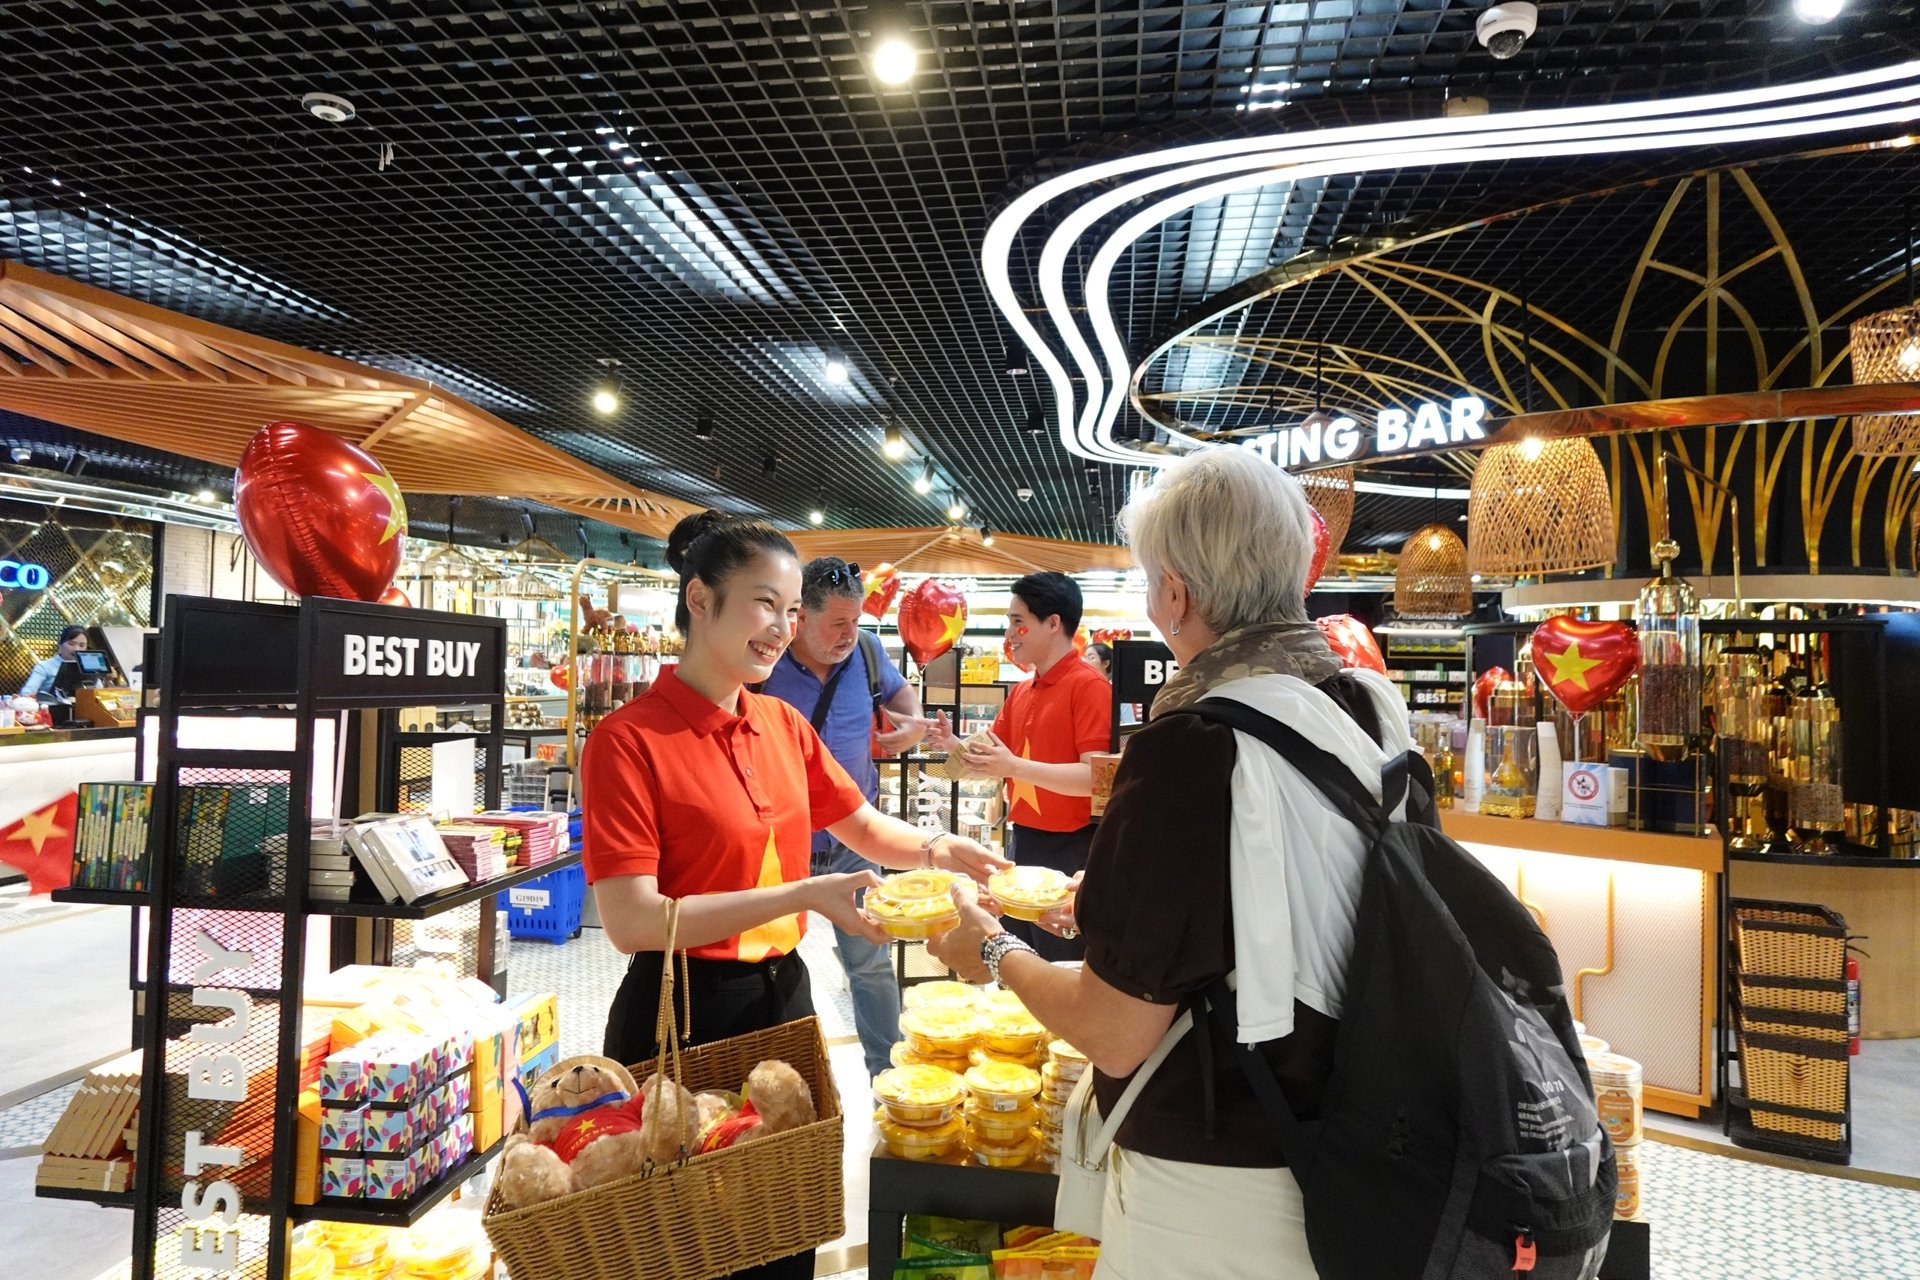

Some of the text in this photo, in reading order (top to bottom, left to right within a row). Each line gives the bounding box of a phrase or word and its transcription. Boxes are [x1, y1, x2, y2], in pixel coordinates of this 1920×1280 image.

[1377, 397, 1487, 452] BAR
[343, 634, 481, 678] BEST BUY
[1416, 692, 1447, 704] BEST
[917, 770, 943, 833] BUY
[187, 929, 253, 1102] BUY
